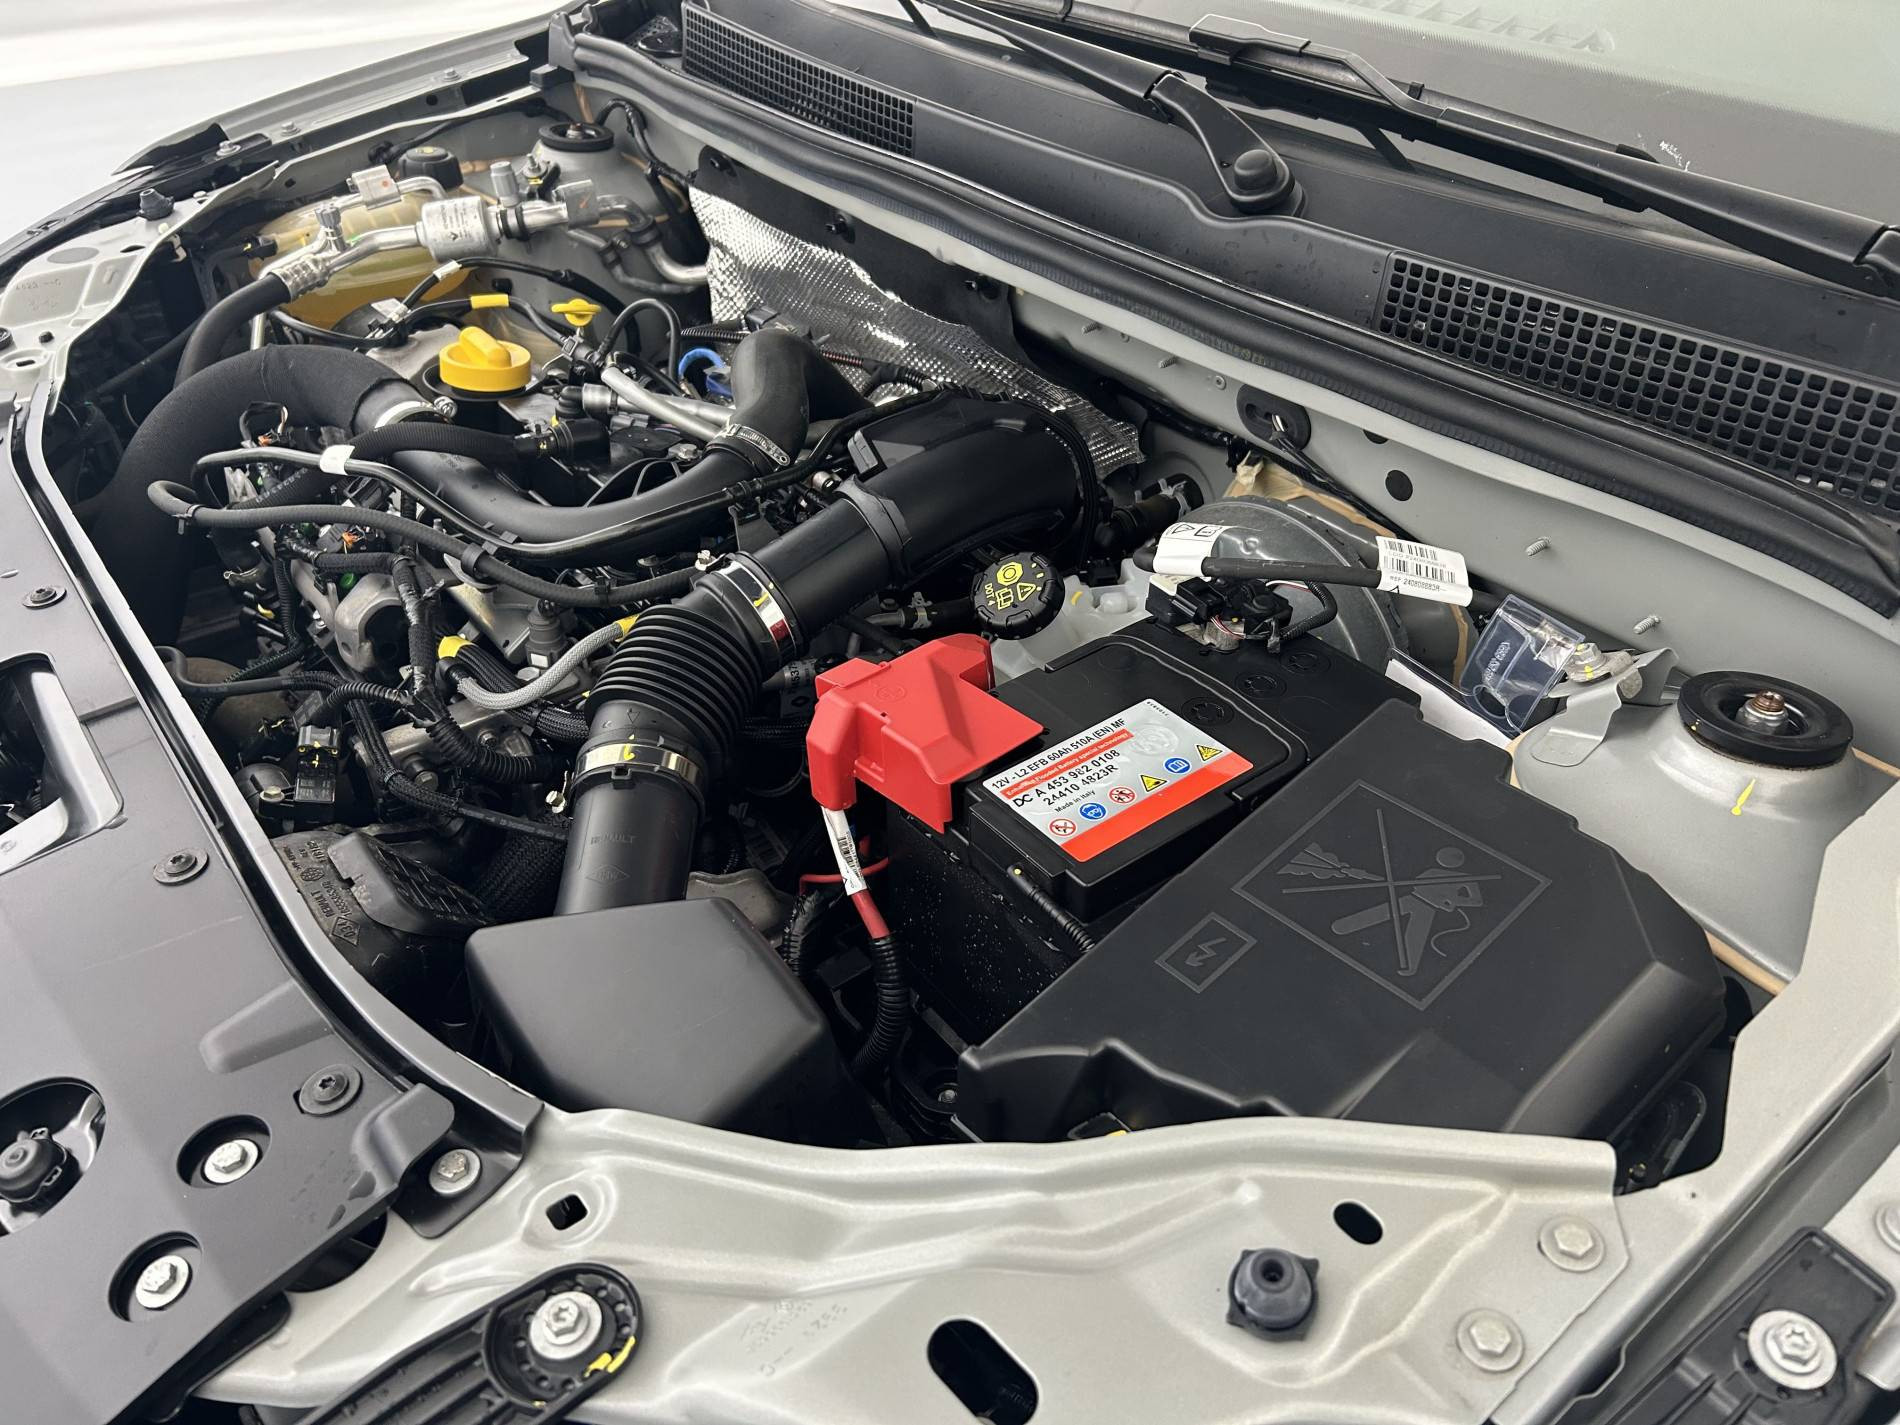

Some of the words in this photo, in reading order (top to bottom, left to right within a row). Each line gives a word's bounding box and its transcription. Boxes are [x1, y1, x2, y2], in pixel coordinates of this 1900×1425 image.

[985, 583, 994, 598] DOT
[992, 776, 1010, 789] 12V
[1014, 768, 1030, 779] L2
[1026, 758, 1048, 772] EFB
[1047, 746, 1072, 761] 60Ah
[1070, 735, 1094, 750] 510A
[1091, 725, 1115, 740] (EN)
[1110, 718, 1126, 730] MF
[1012, 793, 1034, 808] DC
[1035, 788, 1047, 798] A
[1046, 776, 1069, 791] 453
[1068, 764, 1093, 779] 982
[1091, 749, 1121, 768] 0108
[1042, 783, 1080, 806] 24410
[1081, 764, 1119, 786] 4823R
[1054, 801, 1073, 813] Made
[1081, 789, 1096, 801] Italy
